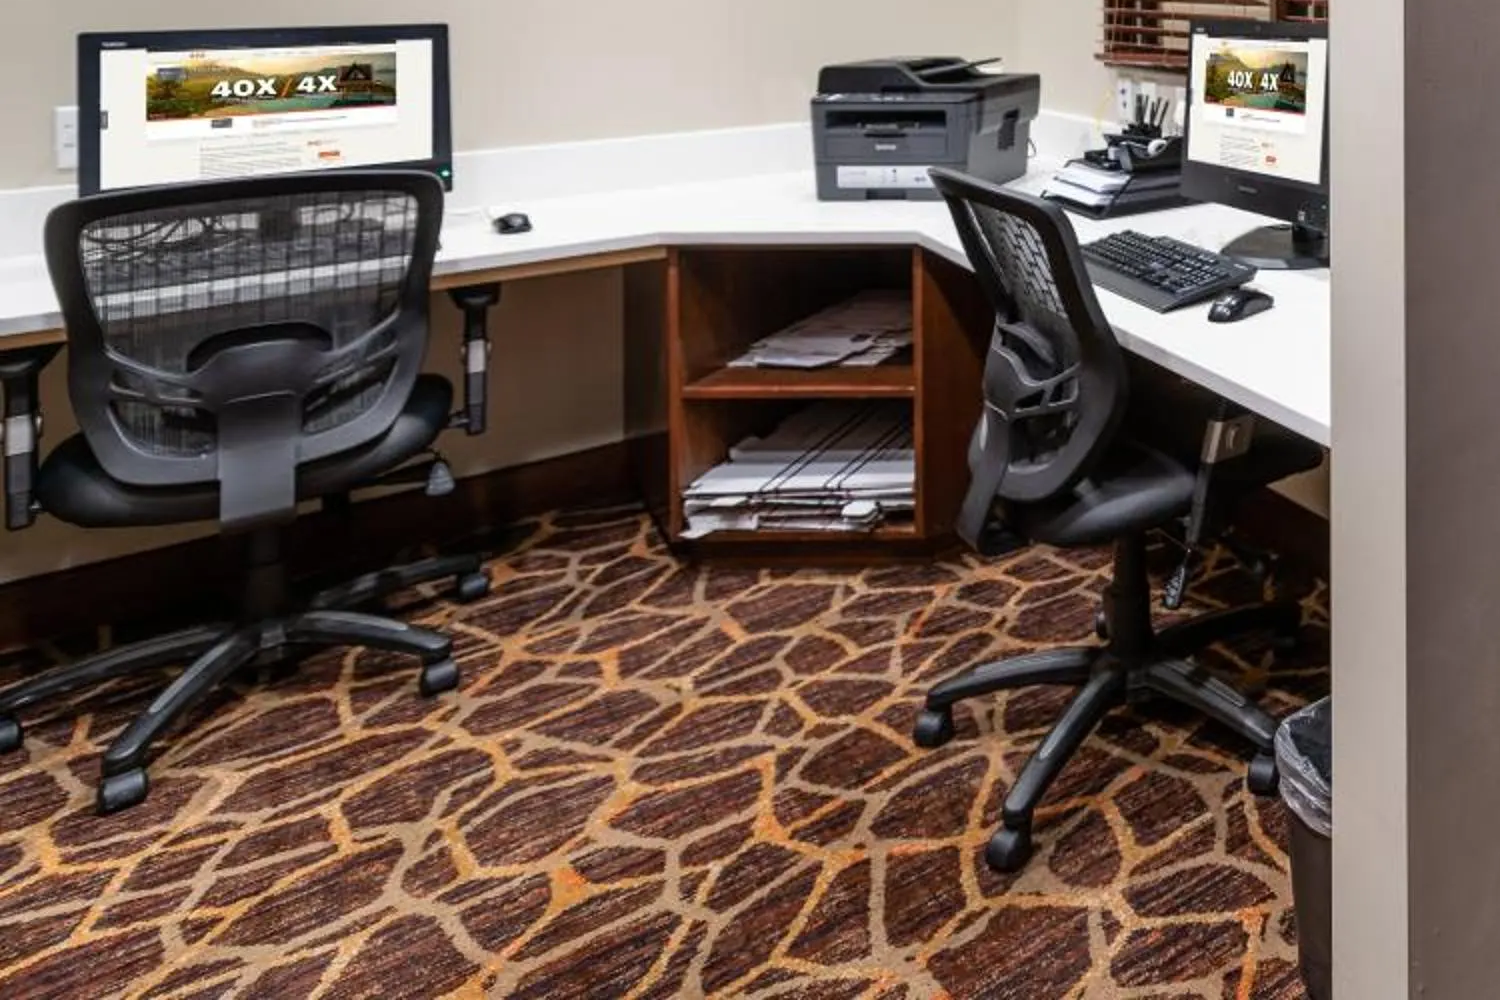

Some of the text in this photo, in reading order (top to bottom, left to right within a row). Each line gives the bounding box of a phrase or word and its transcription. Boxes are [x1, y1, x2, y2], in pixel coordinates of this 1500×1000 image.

[211, 77, 277, 98] 40X
[296, 74, 338, 94] 4X
[1227, 70, 1279, 91] 40X 4X
